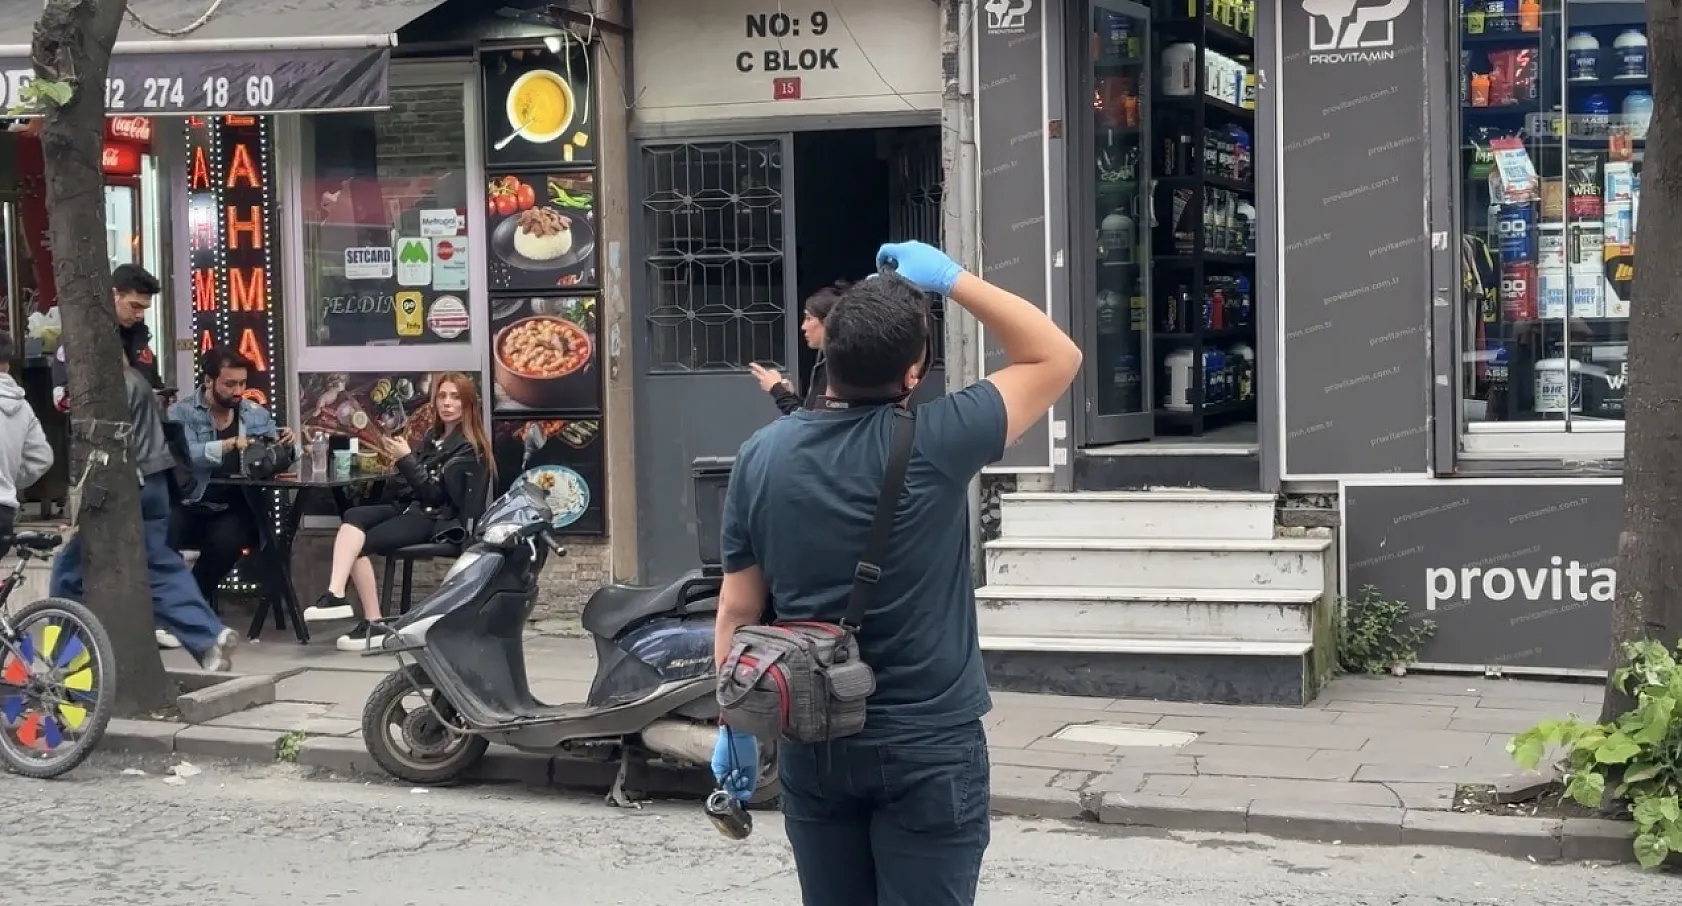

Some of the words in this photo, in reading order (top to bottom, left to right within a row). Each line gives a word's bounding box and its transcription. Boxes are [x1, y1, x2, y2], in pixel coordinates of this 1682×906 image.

[746, 14, 800, 38] NO:
[810, 11, 828, 36] 9
[736, 51, 753, 73] C
[764, 48, 839, 72] BLOK
[1309, 50, 1395, 65] PROVITAMIN
[143, 77, 185, 108] 274
[202, 76, 230, 108] 18
[246, 75, 274, 107] 60
[780, 82, 795, 95] 15
[1322, 174, 1400, 206] provitamin.com.tr
[1573, 184, 1600, 195] WHEY
[347, 250, 391, 264] SETCARD
[1322, 275, 1400, 305] provitamin.com.tr
[1324, 365, 1401, 394] provitamin.com.tr
[1392, 497, 1470, 525] provitamin.com.tr
[1508, 497, 1589, 525] provitamin.com.tr
[1426, 555, 1617, 611] provita
